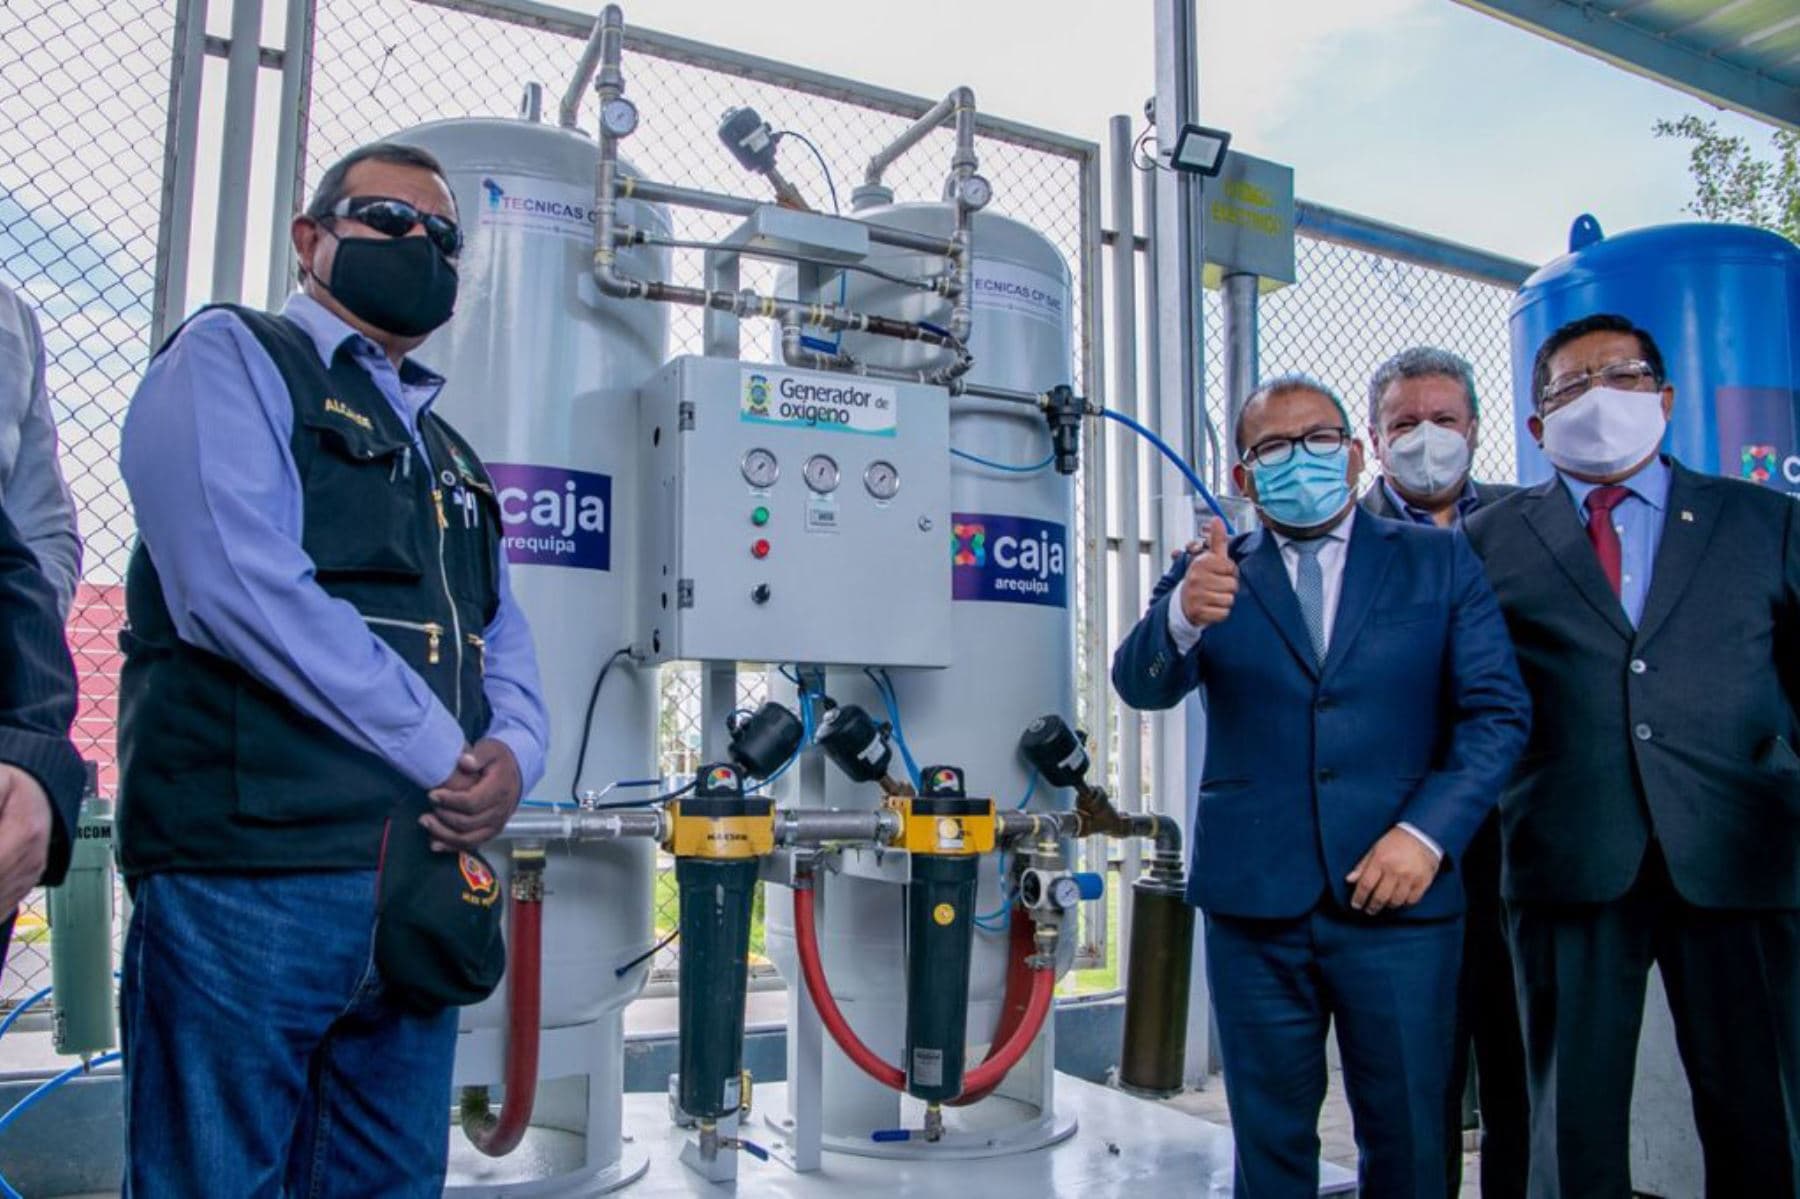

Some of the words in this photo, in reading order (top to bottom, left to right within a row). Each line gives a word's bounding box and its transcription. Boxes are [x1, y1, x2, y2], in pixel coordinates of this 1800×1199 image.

[502, 196, 583, 220] TECNICAS
[780, 378, 872, 407] Generador
[875, 397, 889, 410] de
[780, 400, 850, 427] oxígeno
[498, 480, 604, 537] caja
[993, 530, 1064, 579] caja
[995, 578, 1049, 596] arequipa
